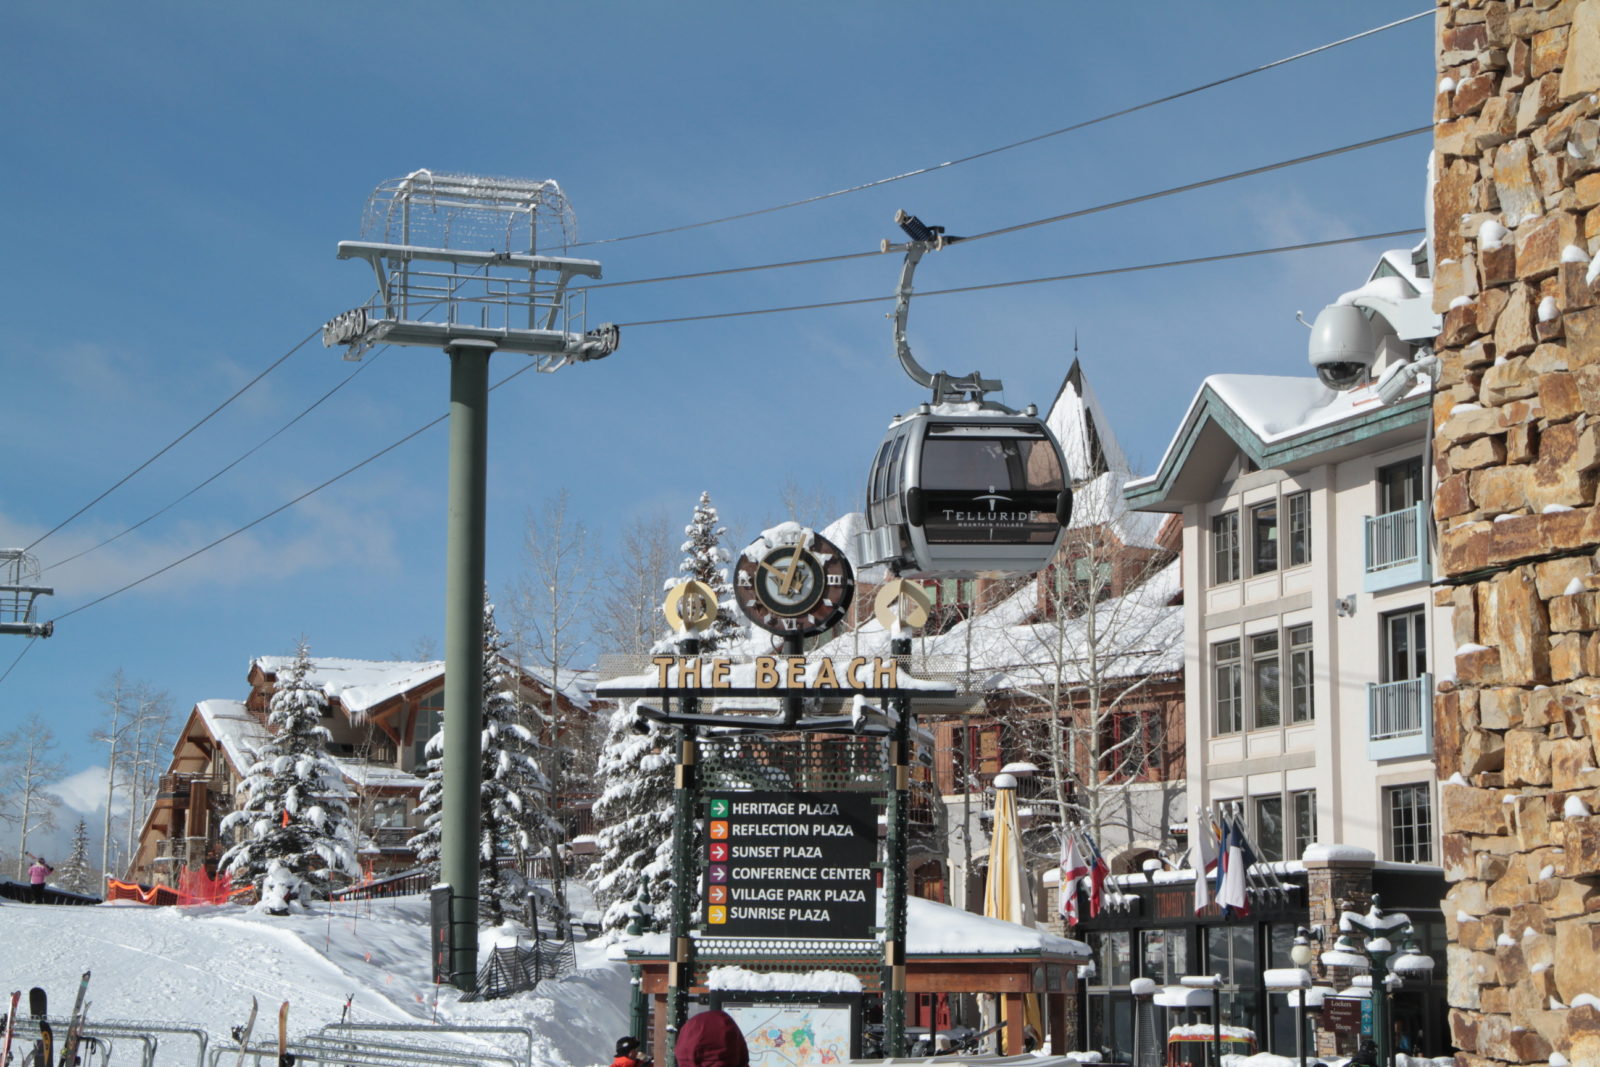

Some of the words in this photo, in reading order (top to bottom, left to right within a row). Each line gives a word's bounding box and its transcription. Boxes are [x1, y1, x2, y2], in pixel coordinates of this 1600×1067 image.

[942, 509, 1039, 521] TELLURIDE
[653, 657, 732, 689] THE
[755, 656, 899, 689] BEACH
[732, 803, 795, 815] HERITAGE
[798, 803, 840, 815] PLAZA
[732, 824, 809, 836] REFLECTION
[812, 824, 854, 836] PLAZA
[732, 846, 780, 858] SUNSET
[783, 846, 823, 858] PLAZA
[732, 867, 817, 879] CONFERENCE
[820, 867, 872, 880] CENTER
[731, 888, 784, 900] VILLAGE
[787, 889, 821, 901] PARK
[824, 890, 866, 902] PLAZA
[730, 907, 786, 919] SUNRISE
[789, 909, 830, 921] PLAZA
